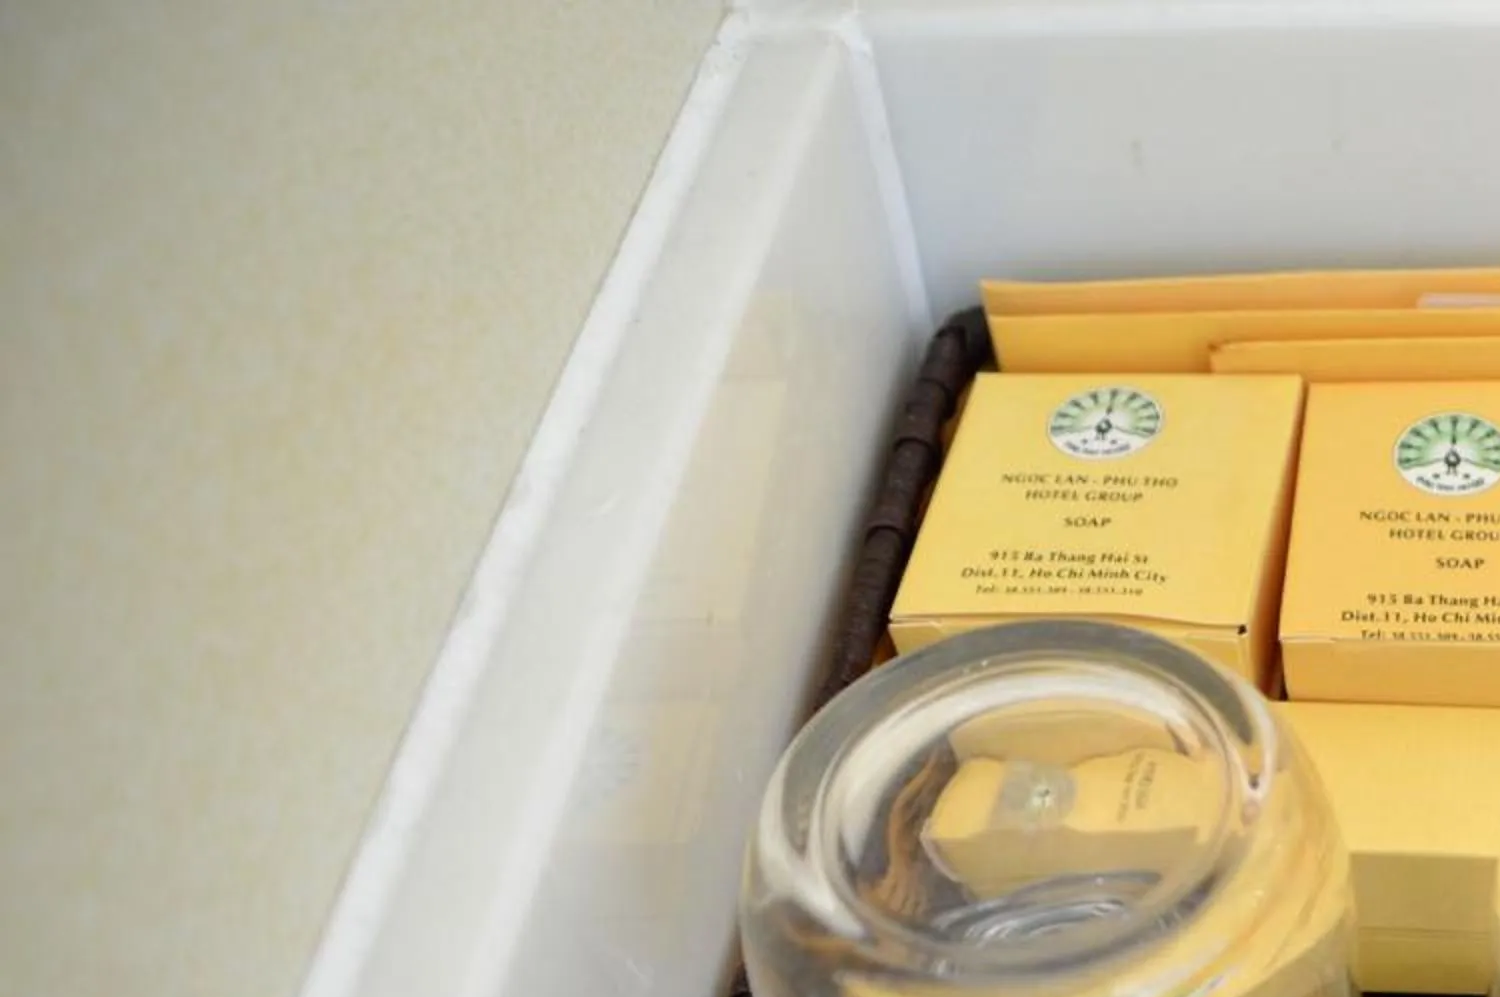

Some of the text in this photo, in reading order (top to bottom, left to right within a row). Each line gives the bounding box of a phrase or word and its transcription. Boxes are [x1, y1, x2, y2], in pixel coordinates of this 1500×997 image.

[1001, 473, 1050, 484] NGOC
[1055, 474, 1089, 485] LAN
[1103, 474, 1138, 487] PHU
[1143, 475, 1179, 488] THO
[1025, 489, 1144, 502] HOTEL GROUP
[1063, 516, 1112, 528] SOAP
[1359, 510, 1411, 523] NGOC
[1415, 511, 1450, 523] LAN
[1389, 528, 1445, 540] HOTEL
[1023, 551, 1043, 562] Ba
[1049, 551, 1096, 565] Thang
[1100, 552, 1129, 565] Hai
[1132, 553, 1149, 565] St
[1436, 557, 1485, 569] SOAP
[1029, 568, 1053, 579] Ho
[1057, 568, 1083, 580] Chi
[1088, 568, 1130, 580] Minh
[1134, 569, 1167, 584] City
[1367, 593, 1397, 606] 915
[1403, 594, 1423, 606] Ba
[1429, 594, 1479, 608] Thang
[1413, 611, 1437, 624] Ho
[1441, 611, 1470, 624] Chi
